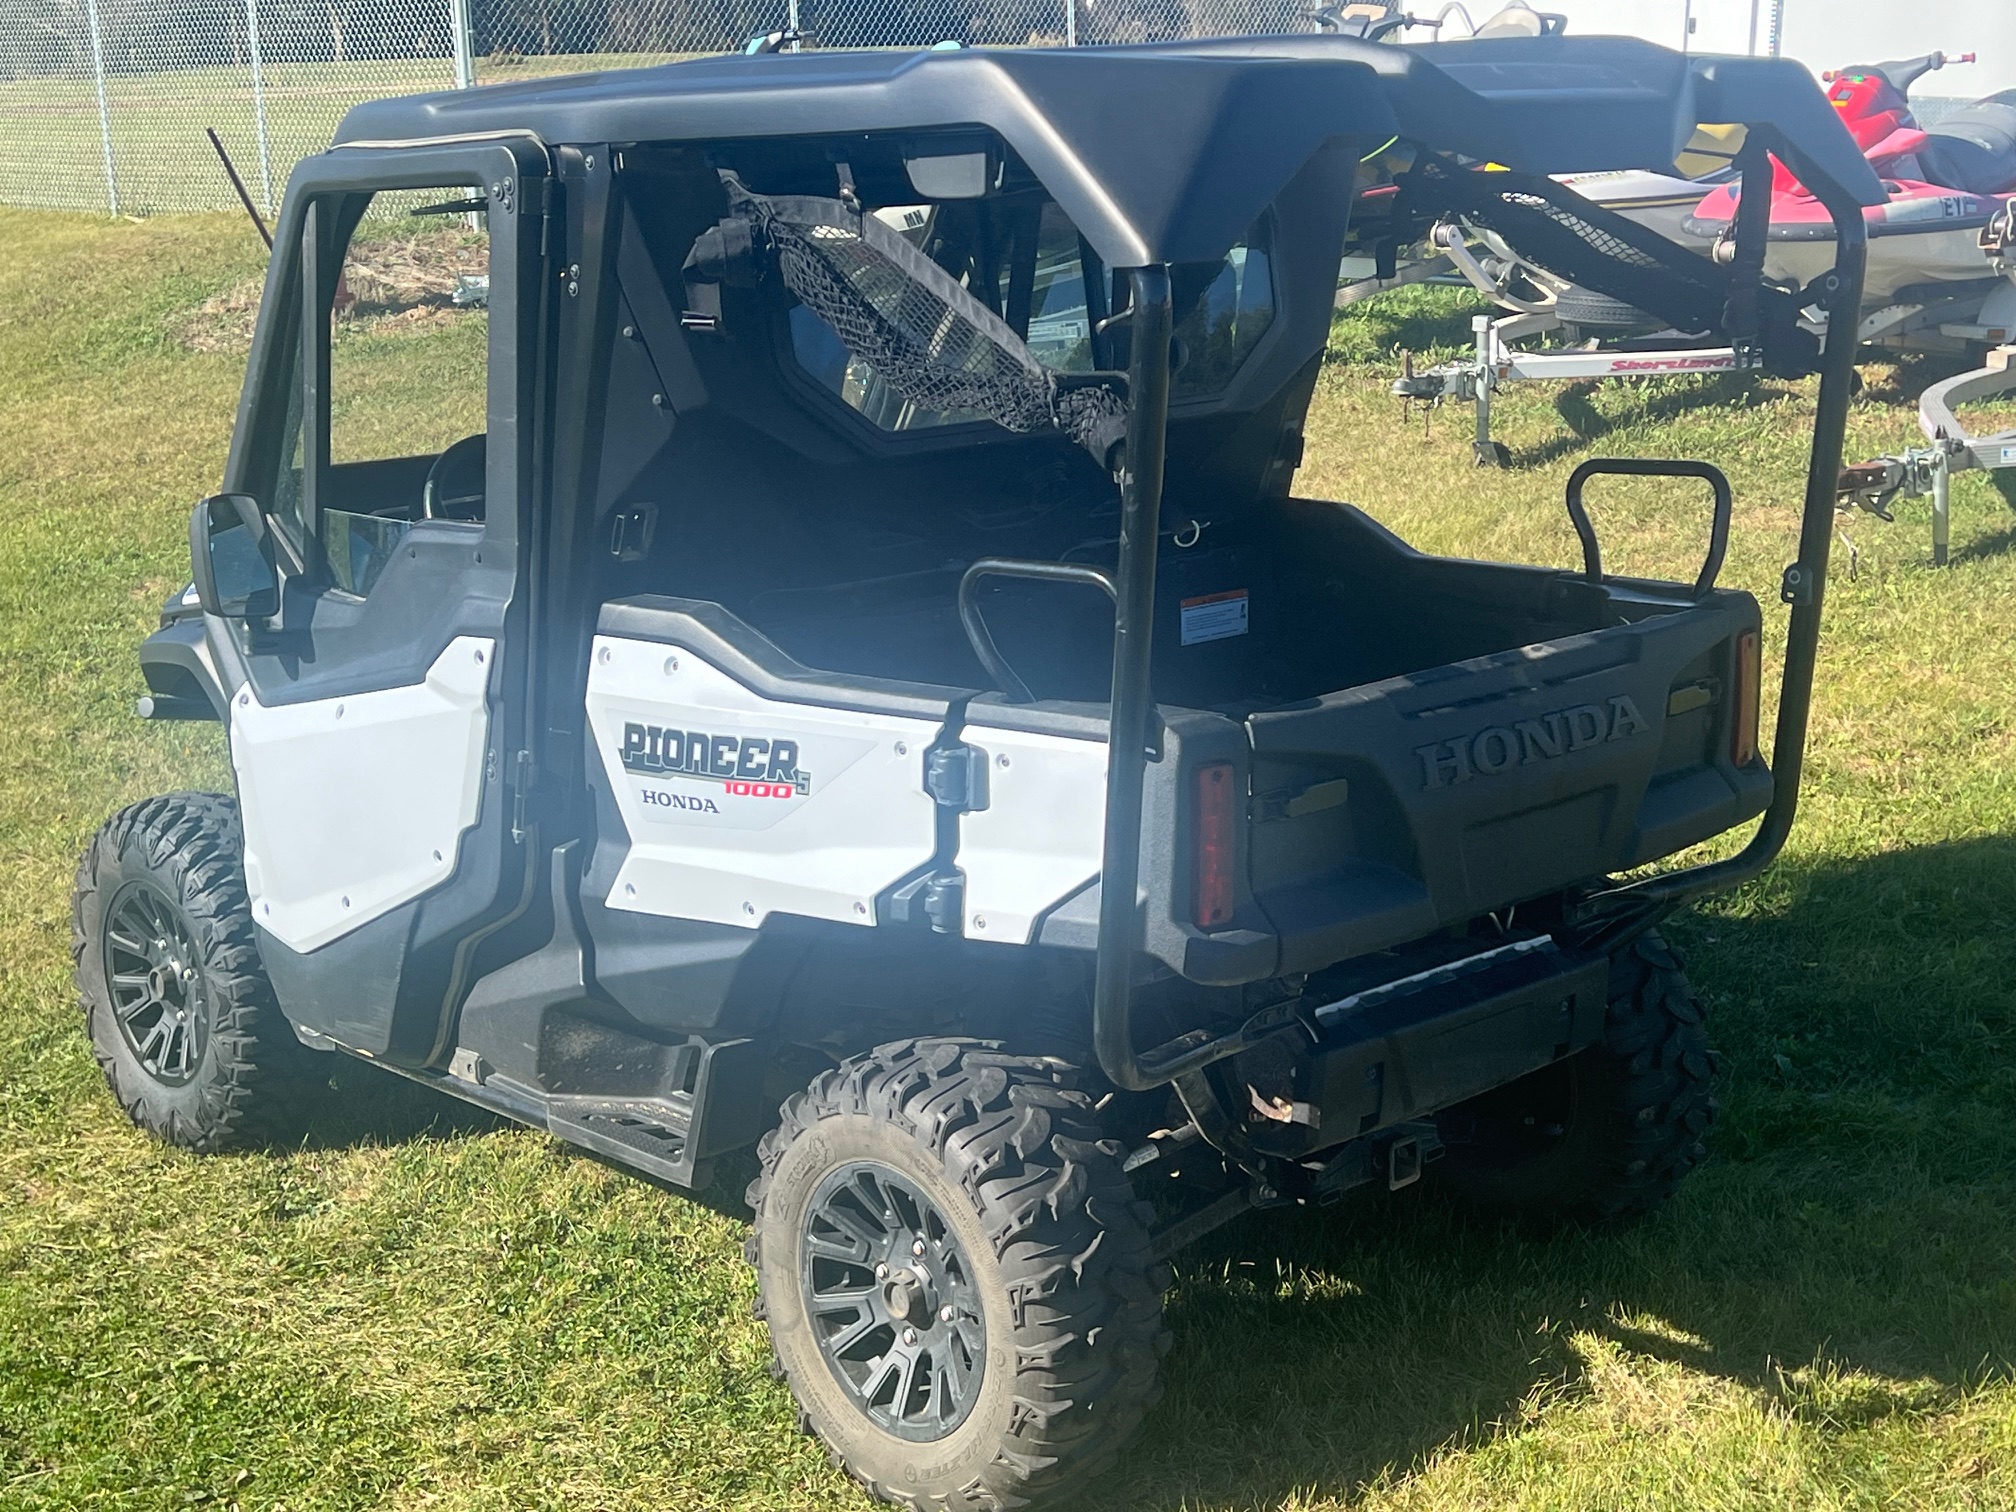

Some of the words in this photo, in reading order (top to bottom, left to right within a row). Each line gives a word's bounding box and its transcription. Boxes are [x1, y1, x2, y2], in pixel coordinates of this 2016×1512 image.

[904, 210, 925, 228] MN
[624, 721, 799, 781] PIONEER
[1413, 693, 1650, 791] HONDA
[641, 789, 720, 814] HONDA
[724, 781, 793, 798] 1000
